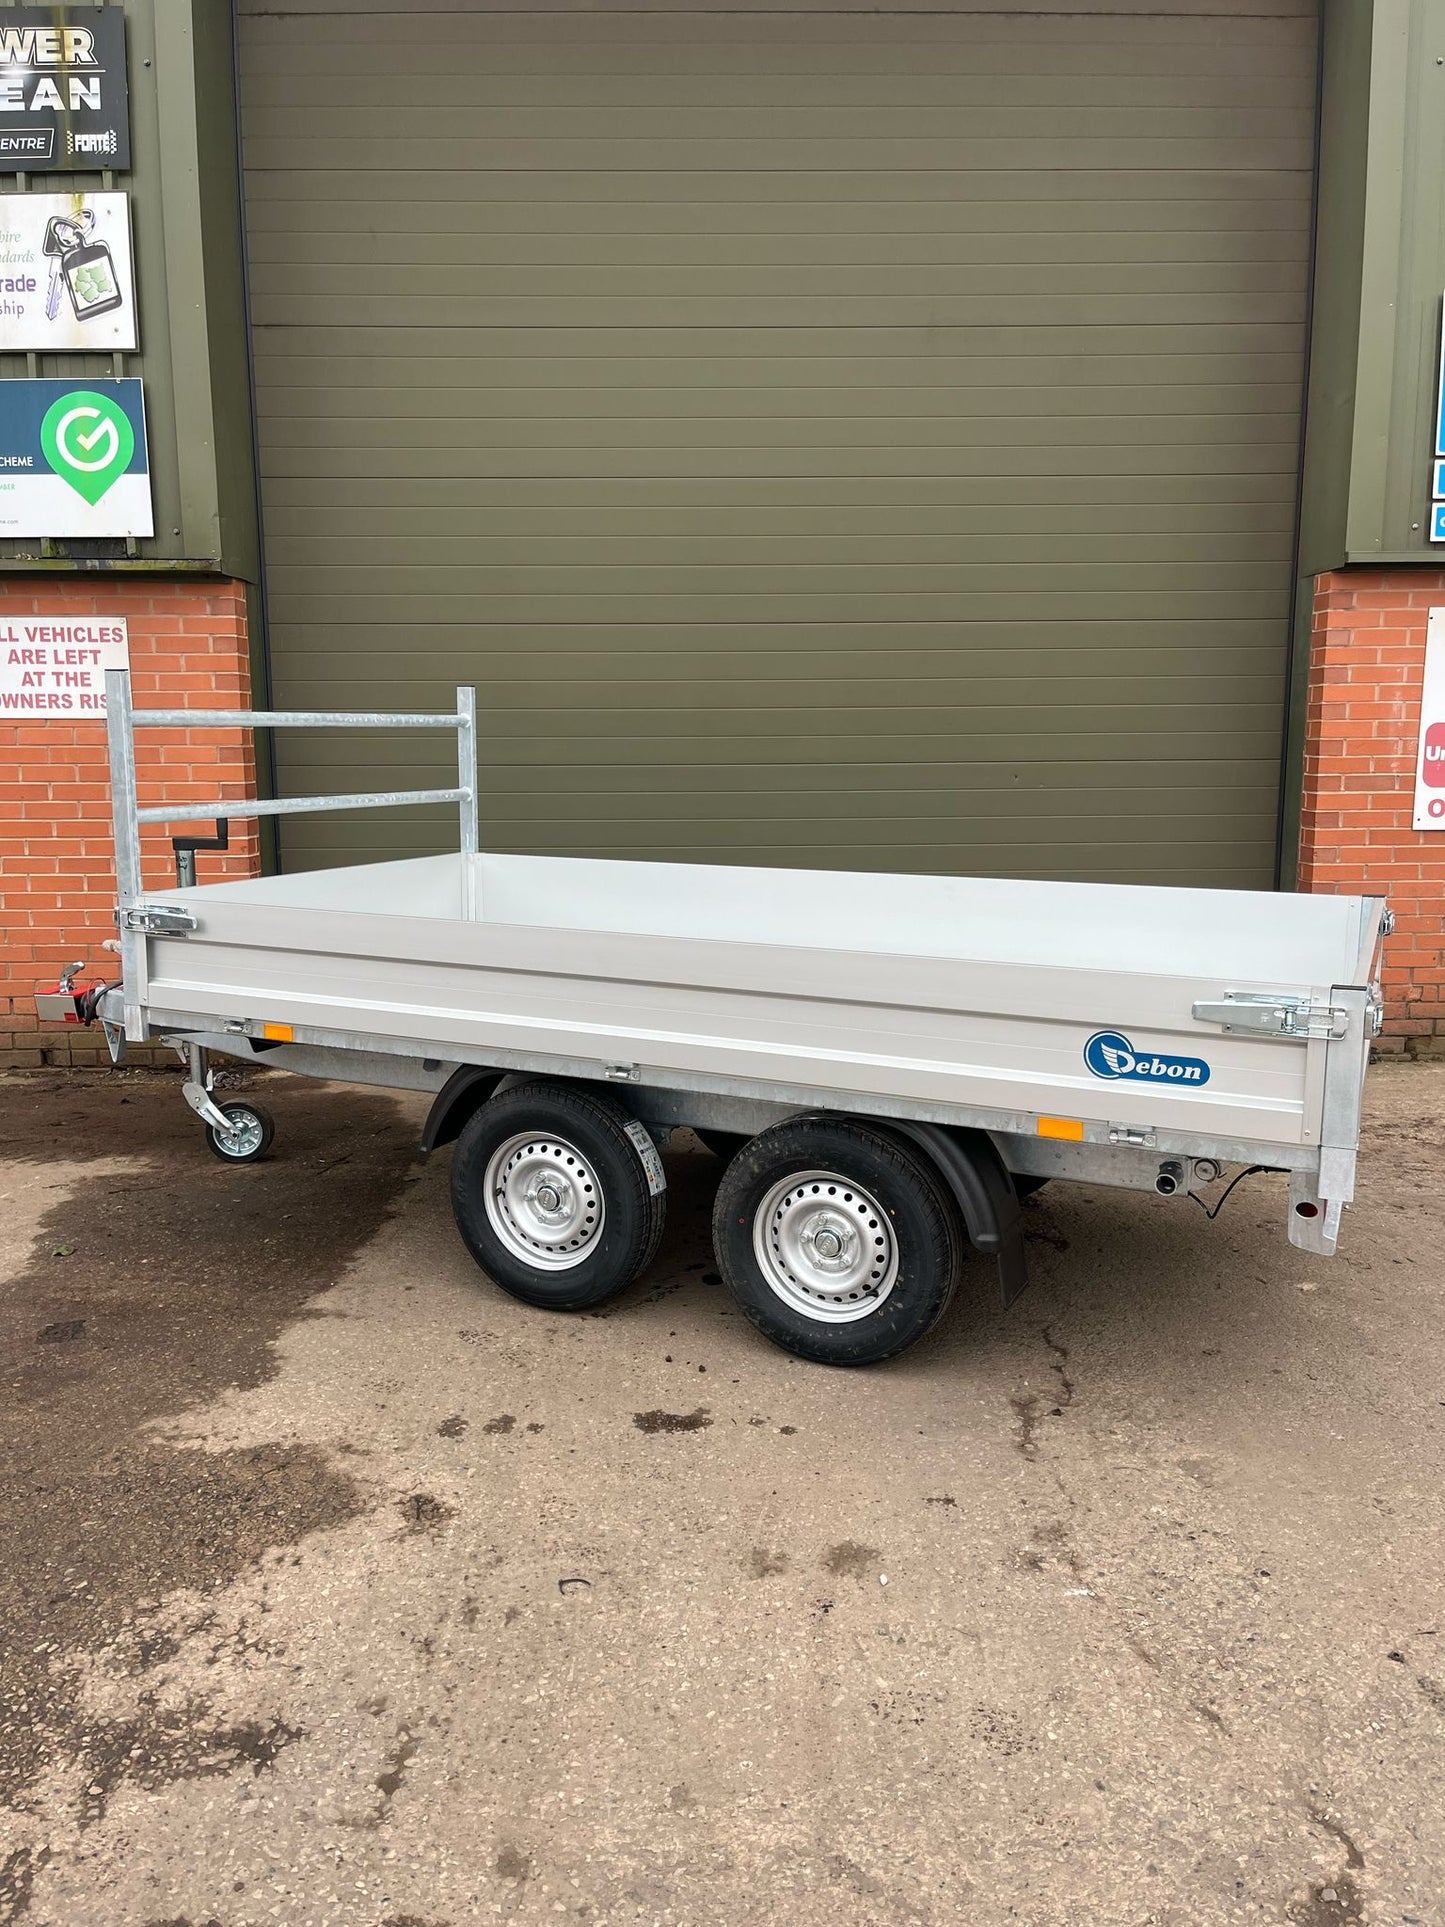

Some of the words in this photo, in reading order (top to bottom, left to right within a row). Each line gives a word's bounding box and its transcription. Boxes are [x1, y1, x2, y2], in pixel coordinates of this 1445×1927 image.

[0, 77, 102, 111] EAN
[0, 137, 46, 150] ENTRE
[25, 627, 124, 643] VEHICLES
[8, 649, 47, 665] ARE
[54, 649, 101, 665] LEFT
[22, 671, 45, 687] AT
[52, 671, 92, 687] THE
[0, 693, 73, 709] WNERS
[1101, 1042, 1201, 1080] Debon
